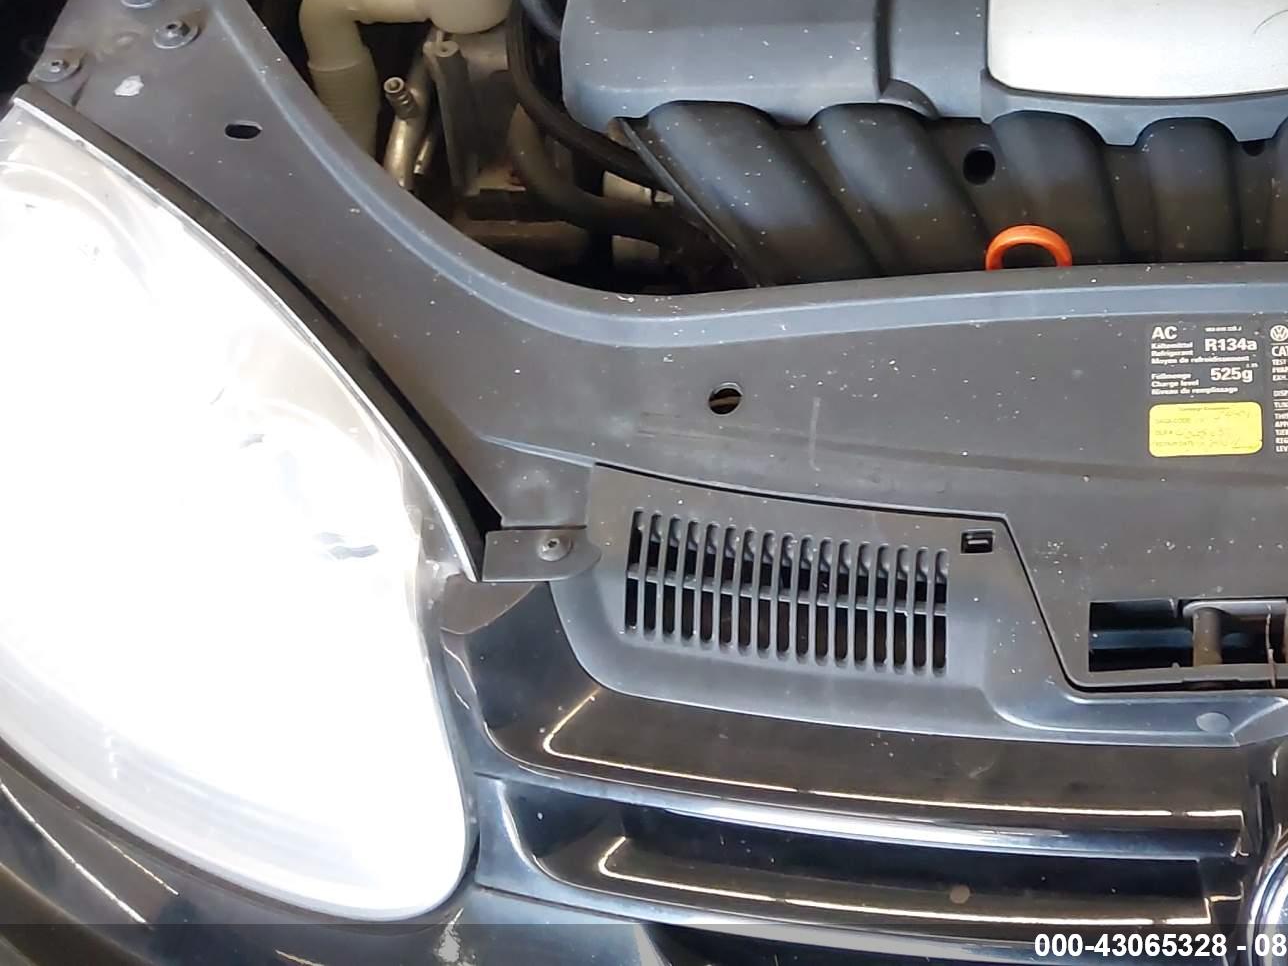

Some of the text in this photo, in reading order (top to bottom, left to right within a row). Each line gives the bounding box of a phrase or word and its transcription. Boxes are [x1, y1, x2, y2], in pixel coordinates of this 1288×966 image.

[1151, 326, 1178, 340] AC
[1205, 338, 1257, 351] R134a
[1210, 367, 1253, 383] 525g
